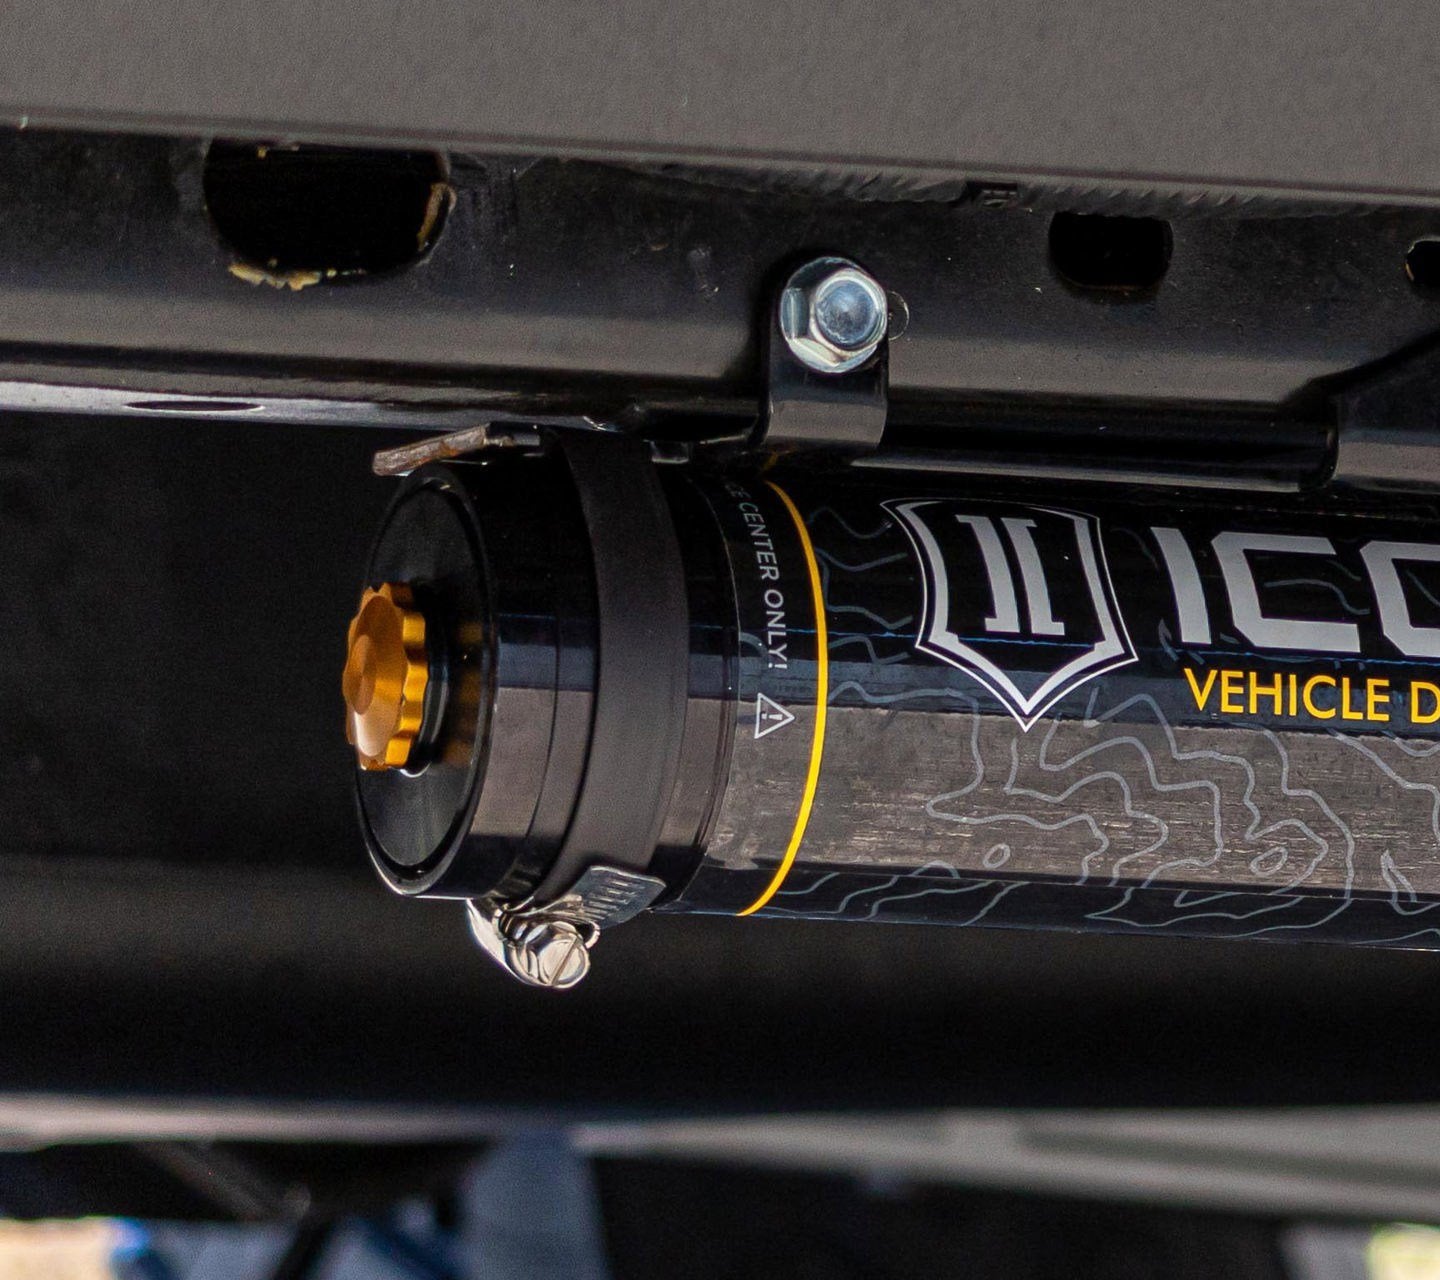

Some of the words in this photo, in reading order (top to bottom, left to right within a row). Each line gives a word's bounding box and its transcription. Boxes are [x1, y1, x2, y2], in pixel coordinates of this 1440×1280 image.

[738, 500, 780, 581] CENTER
[763, 588, 788, 670] ONLY!
[1183, 667, 1389, 724] VEHICLE
